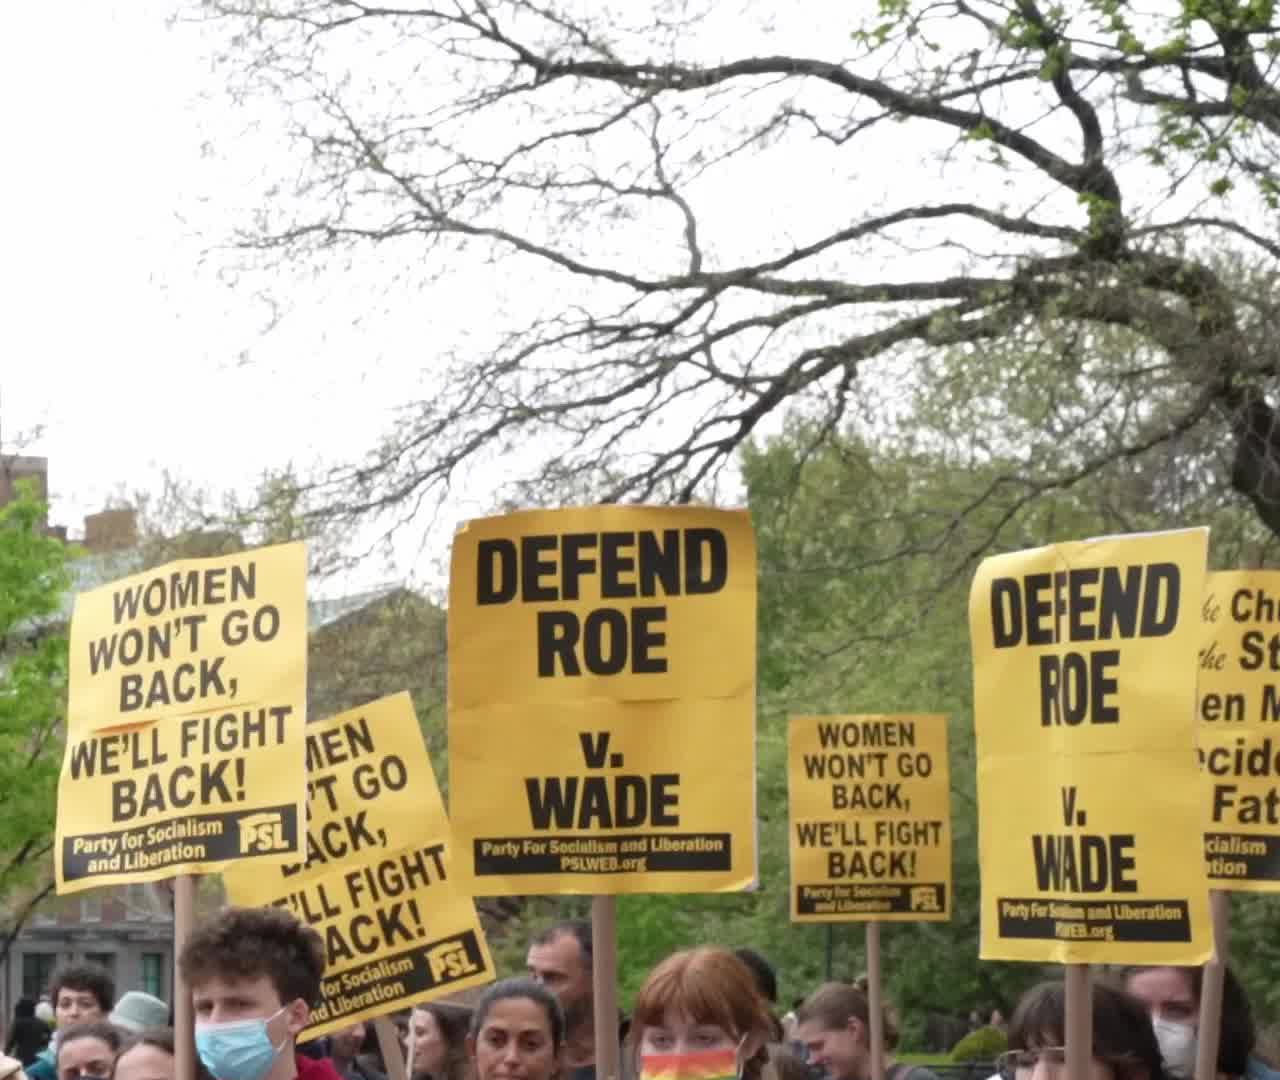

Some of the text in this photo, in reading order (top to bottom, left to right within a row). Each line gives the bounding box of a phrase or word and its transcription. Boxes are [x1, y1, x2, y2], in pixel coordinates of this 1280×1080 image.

[477, 528, 728, 606] DEFEND
[112, 562, 257, 625] WOMEN
[991, 562, 1181, 649] DEFEND
[1201, 592, 1220, 623] he
[89, 604, 281, 675] WON'T GO
[537, 606, 667, 678] ROE
[119, 657, 238, 713] BACK,
[1039, 650, 1120, 727] ROE
[1201, 692, 1246, 722] en
[70, 706, 293, 781] WE'LL FIGHT
[306, 717, 375, 772] MEN
[817, 721, 916, 748] WOMEN
[1197, 737, 1280, 777] cid
[352, 755, 408, 801] GO
[803, 752, 933, 779] WON'T GO
[111, 758, 246, 823] BACK!
[524, 774, 680, 830] WADE
[832, 783, 910, 813] BACK,
[72, 836, 117, 858] Party
[121, 829, 144, 850] for
[146, 819, 224, 844] Socialism
[281, 811, 388, 878] ACK,
[482, 842, 520, 858] Party
[550, 839, 618, 855] Socialism
[651, 837, 723, 852] Liberation
[796, 820, 943, 847] WE'LL FIGHT
[1205, 836, 1267, 856] cialism
[87, 843, 206, 874] and Liberation
[344, 844, 448, 909] FIGHT
[827, 851, 917, 879] BACK!
[1032, 834, 1137, 895] WADE
[325, 898, 427, 967] ACK!
[1115, 904, 1182, 921] Liberation
[343, 953, 415, 989] Socialism
[309, 981, 406, 1024] nd Liberation
